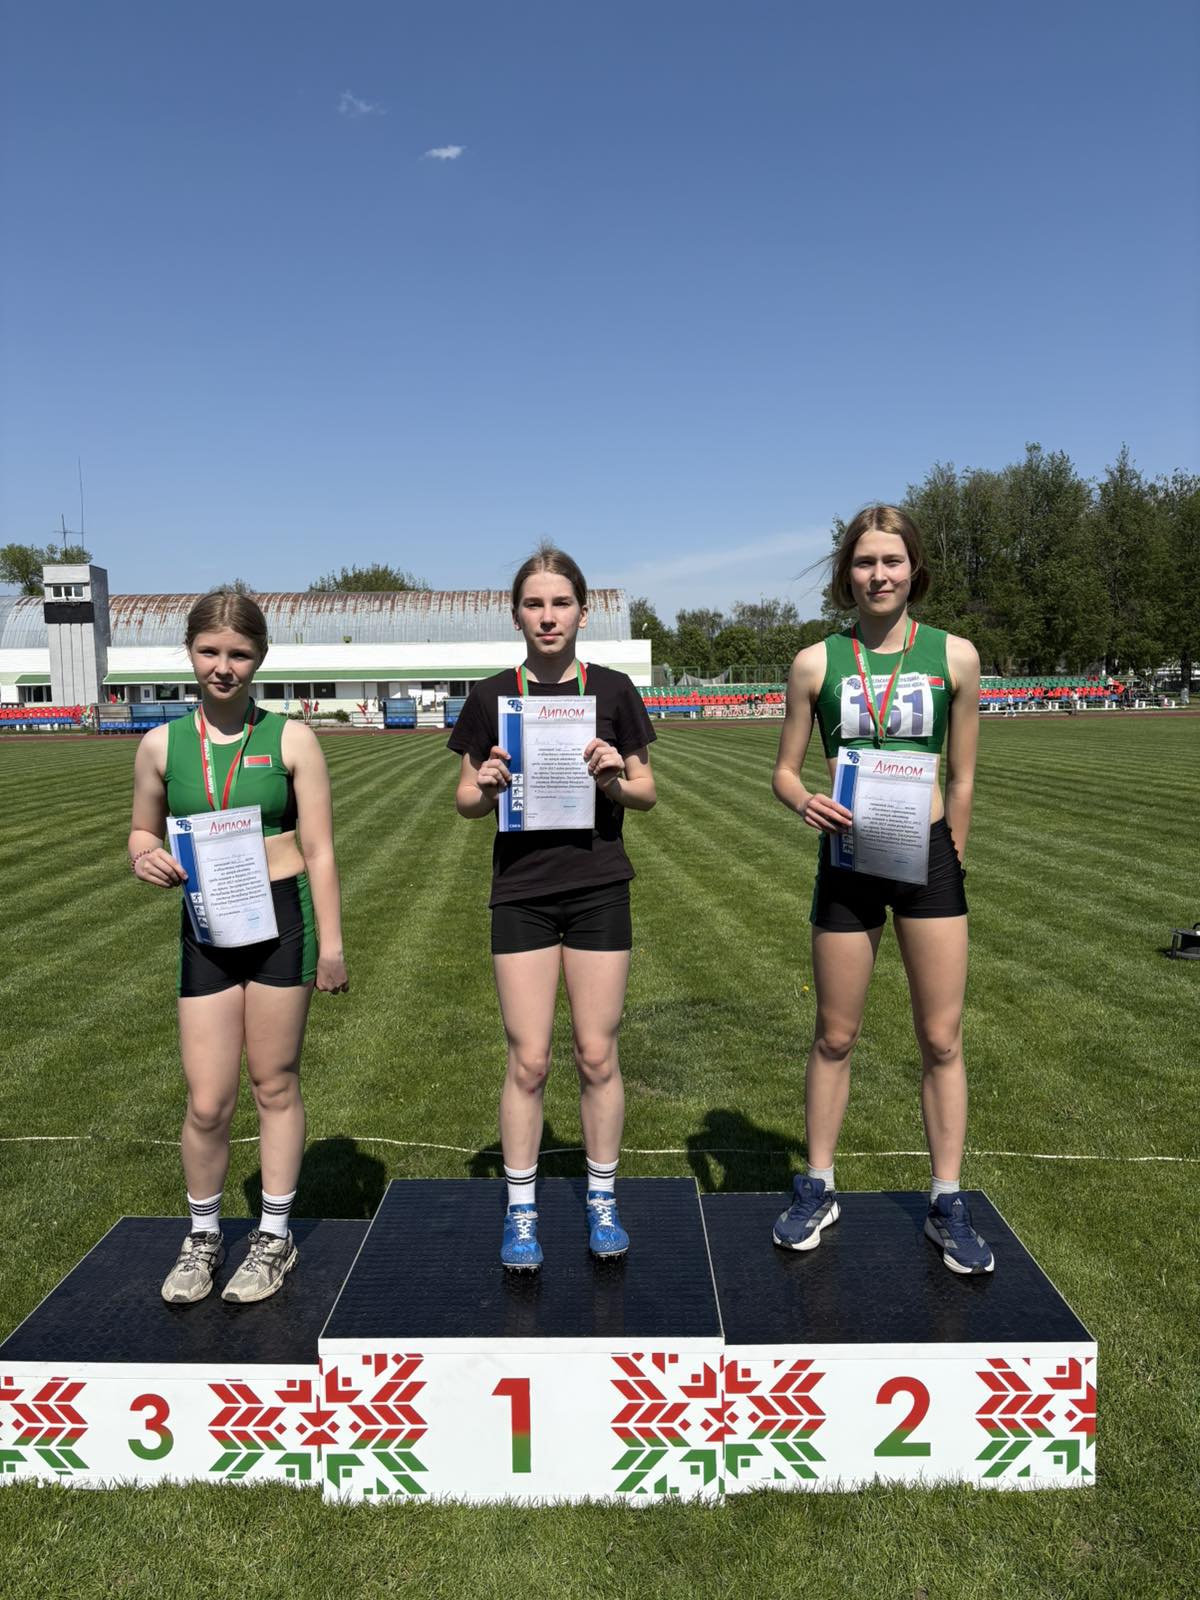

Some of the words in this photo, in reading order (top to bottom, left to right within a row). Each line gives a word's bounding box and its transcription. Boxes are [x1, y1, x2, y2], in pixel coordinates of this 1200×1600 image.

[128, 1393, 174, 1460] 3
[491, 1378, 531, 1473] 1
[874, 1376, 931, 1457] 2
